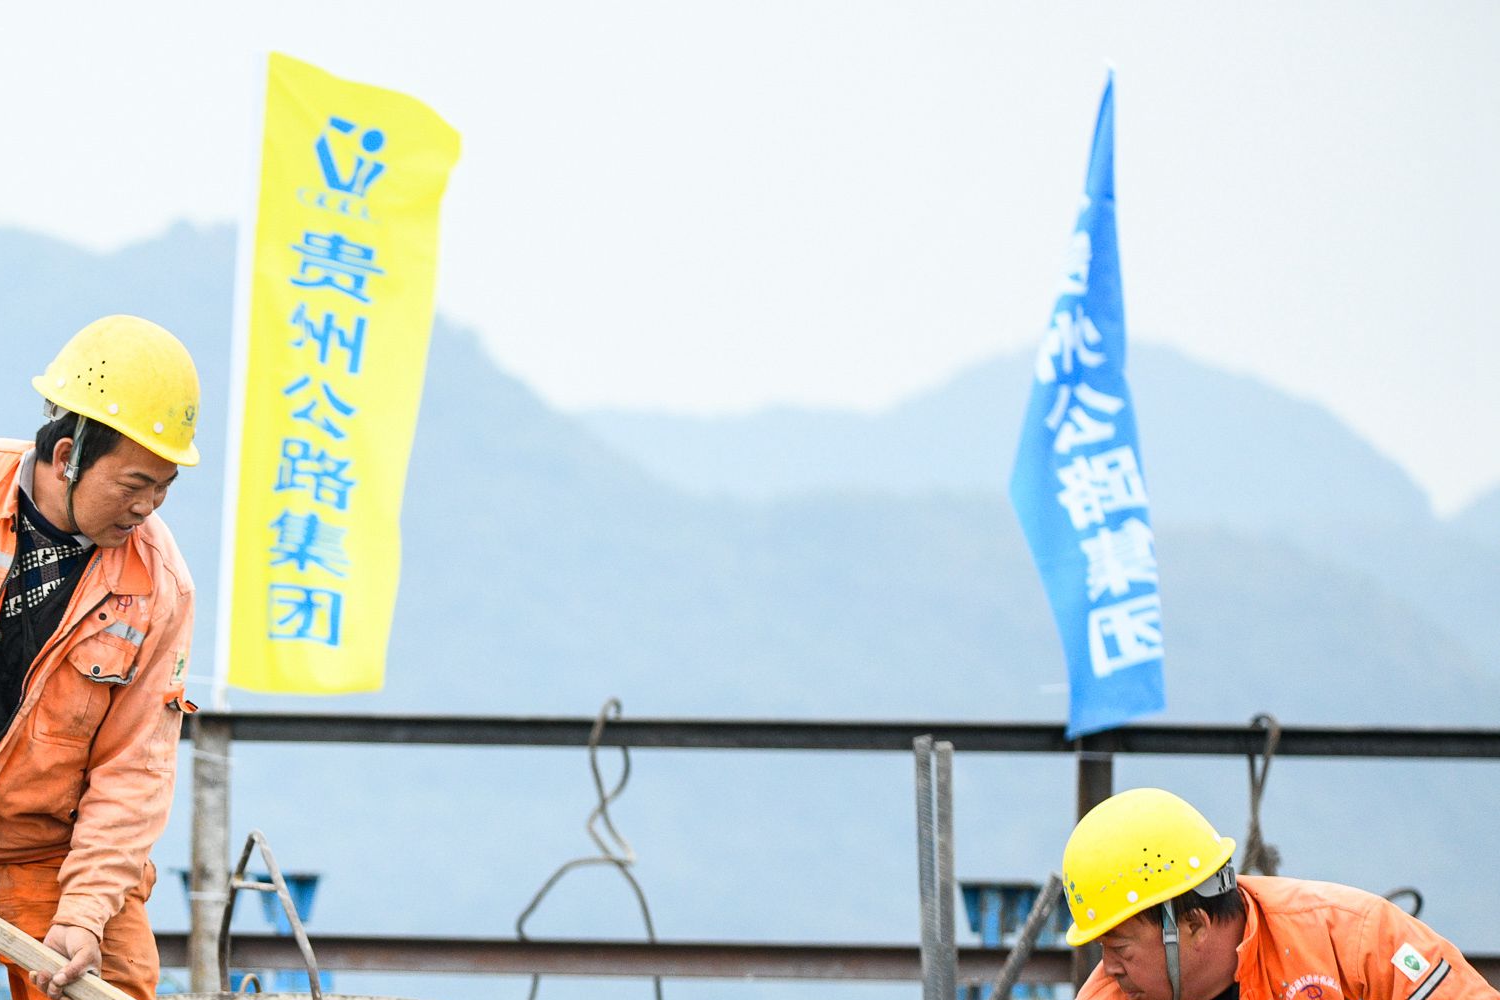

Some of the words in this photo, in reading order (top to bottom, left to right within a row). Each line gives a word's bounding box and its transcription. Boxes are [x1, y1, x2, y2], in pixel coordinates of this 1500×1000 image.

[267, 231, 386, 647] 贵州公路集团
